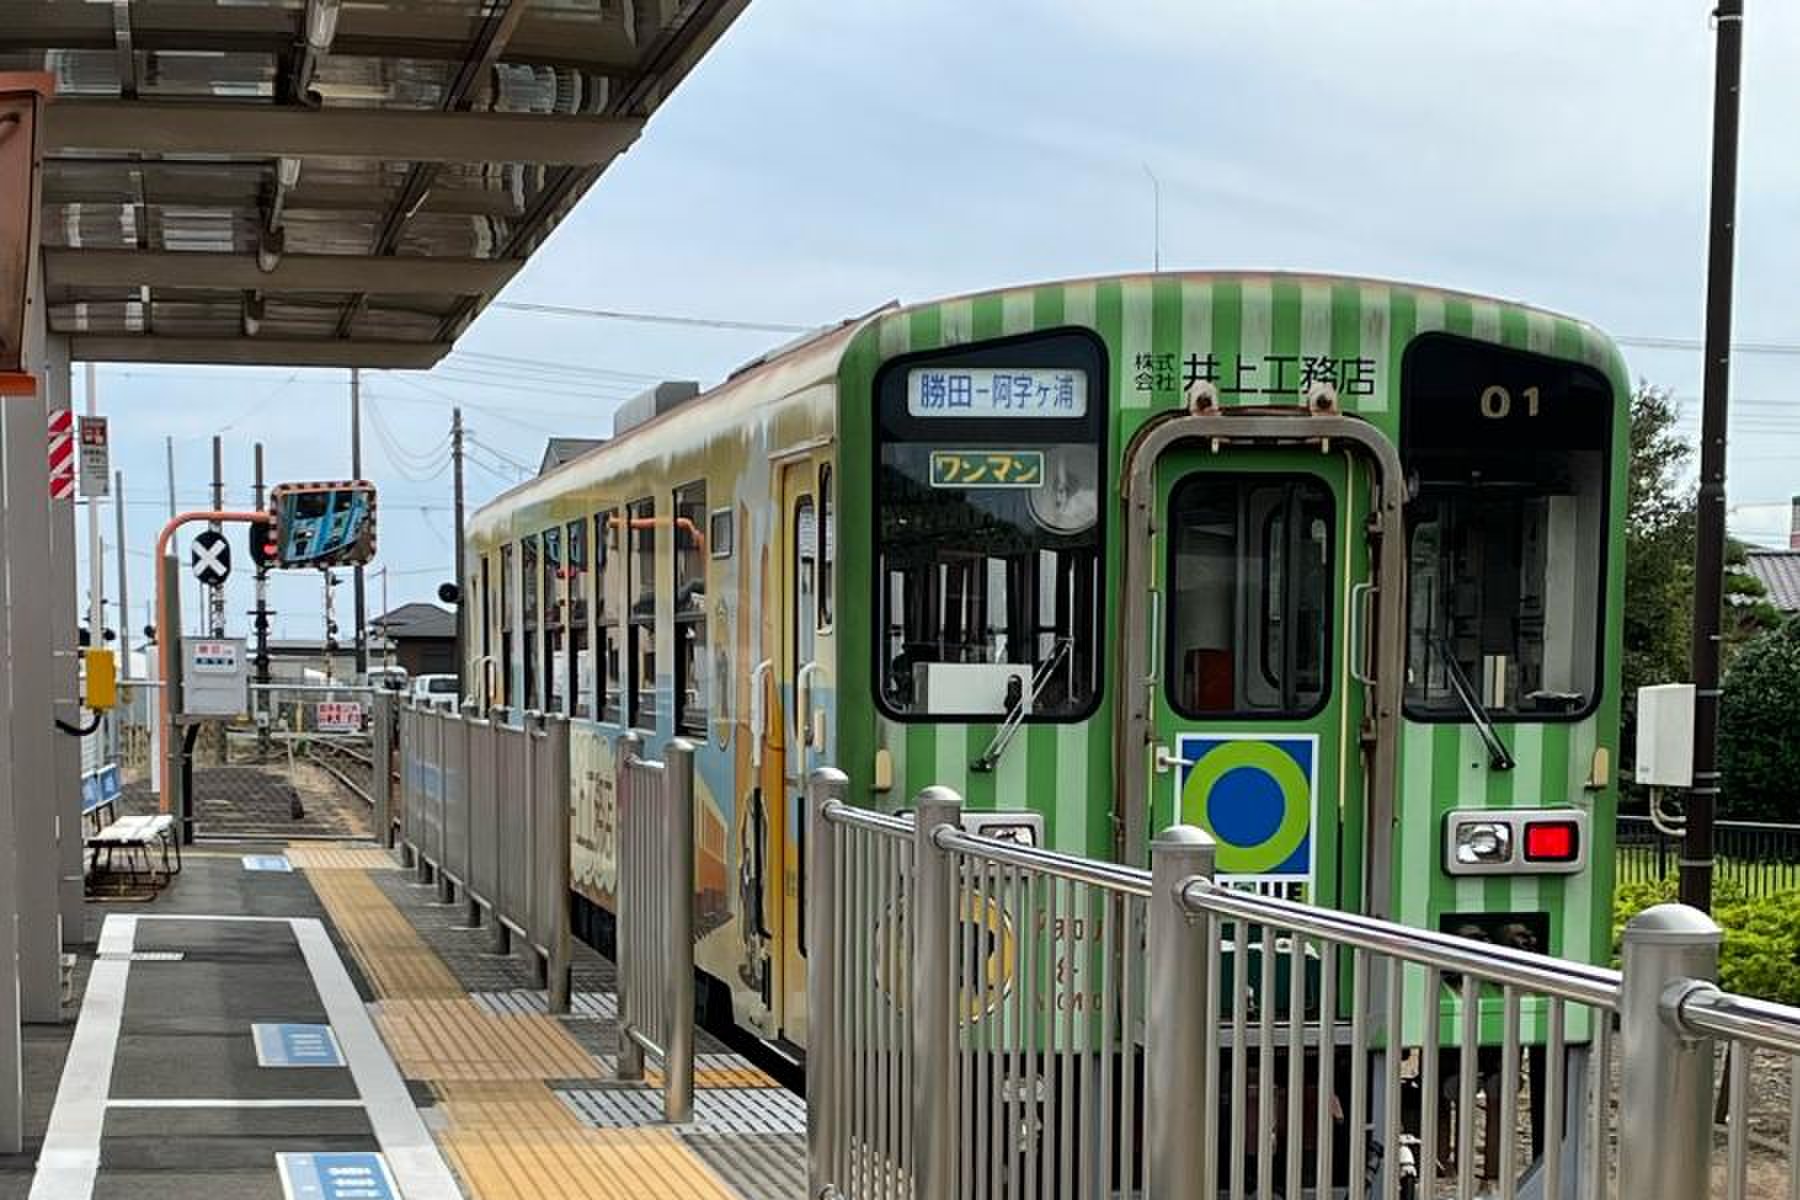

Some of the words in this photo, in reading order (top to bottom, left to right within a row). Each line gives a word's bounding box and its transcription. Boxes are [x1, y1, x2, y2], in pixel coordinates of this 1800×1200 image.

[1135, 353, 1175, 371] 株式
[1183, 353, 1376, 395] 井上工務店
[1135, 372, 1175, 391] 会社
[1481, 385, 1539, 418] 01
[935, 455, 1039, 482] ワンマン
